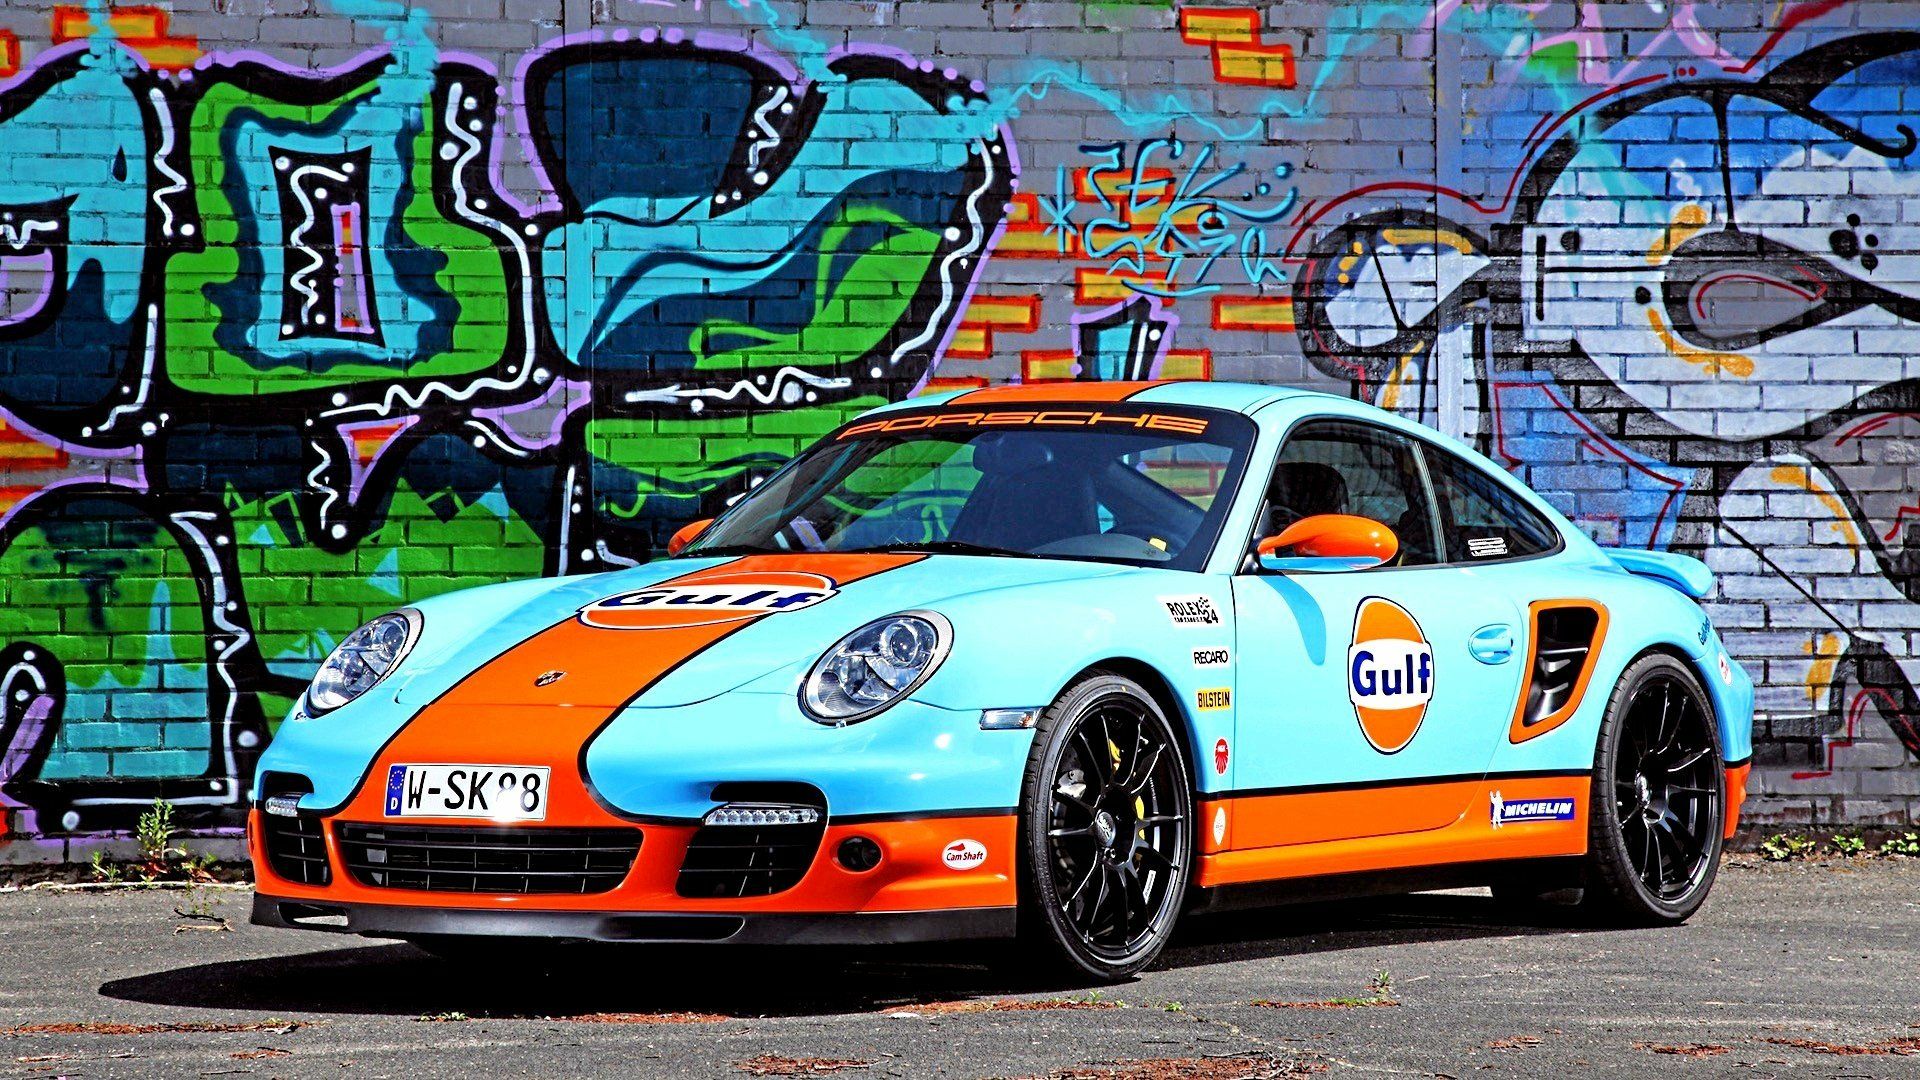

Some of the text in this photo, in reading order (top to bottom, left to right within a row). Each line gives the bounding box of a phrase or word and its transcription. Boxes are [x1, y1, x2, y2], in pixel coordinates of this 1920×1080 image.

[836, 411, 1209, 440] PORSCHE
[597, 589, 826, 609] Gulf
[1165, 601, 1219, 624] ROLEX 24
[1193, 650, 1229, 664] RECARO
[1351, 650, 1431, 697] Gulf
[1197, 691, 1230, 708] BILSTEIN
[390, 796, 399, 811] D
[1504, 802, 1573, 817] MICHELIN
[946, 850, 984, 861] Cam Shaft
